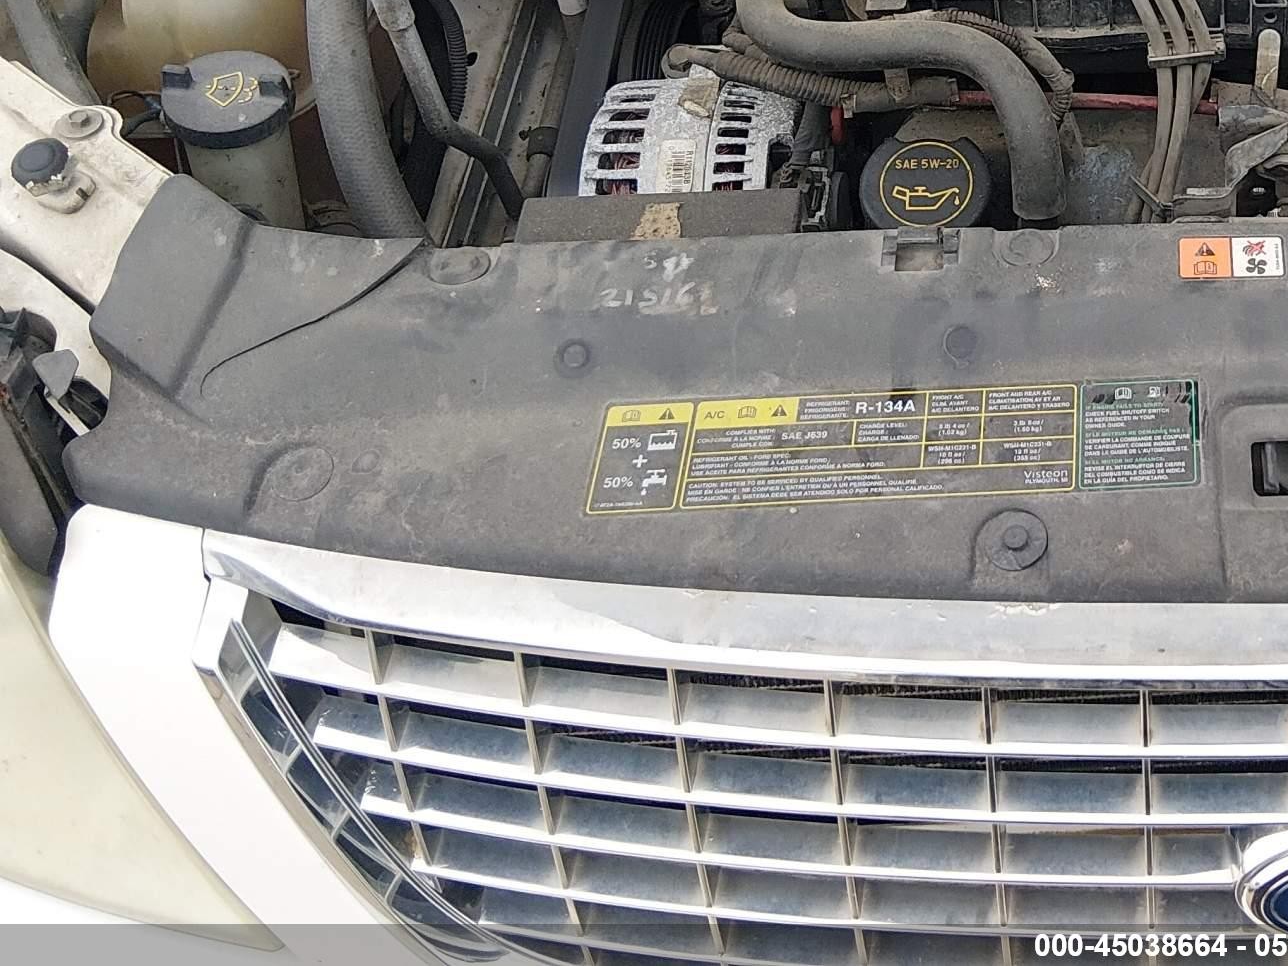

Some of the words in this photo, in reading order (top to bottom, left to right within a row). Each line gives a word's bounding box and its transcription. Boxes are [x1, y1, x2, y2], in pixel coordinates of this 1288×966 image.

[895, 158, 918, 170] SAE
[921, 157, 959, 169] 5W-20
[856, 399, 915, 414] R-134A
[704, 410, 725, 420] A/C
[781, 432, 802, 441] SAE
[612, 438, 641, 449] 50%
[1024, 470, 1068, 478] Visteon
[603, 476, 634, 488] 50%
